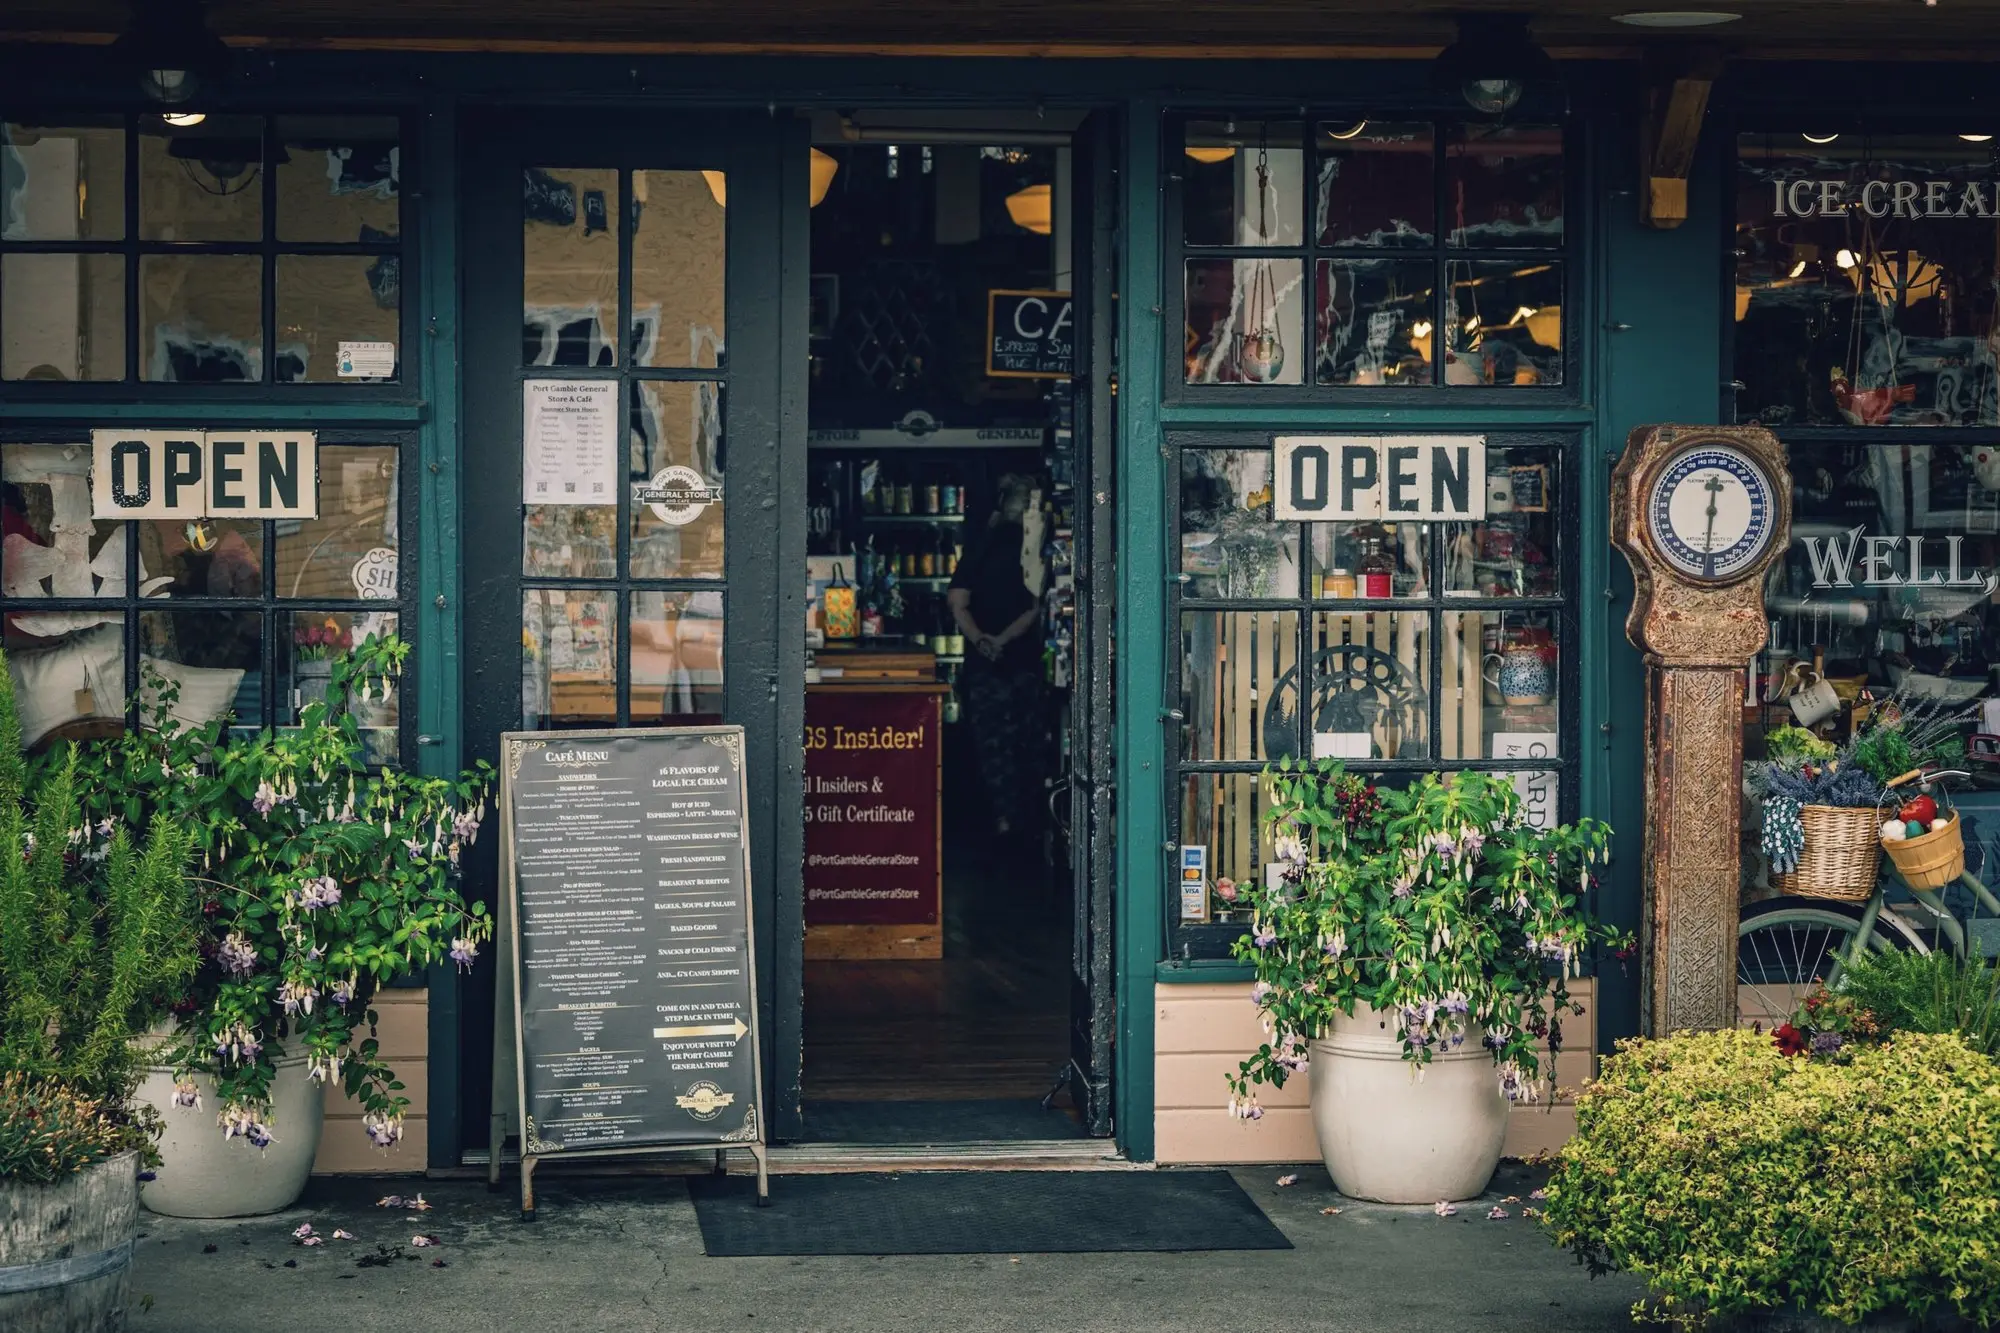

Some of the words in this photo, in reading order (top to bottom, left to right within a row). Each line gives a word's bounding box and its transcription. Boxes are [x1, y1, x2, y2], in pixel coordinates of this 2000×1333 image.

[1773, 180, 1849, 217] ICE
[1862, 180, 2000, 220] CREA
[976, 428, 1040, 440] GENERAL
[111, 441, 298, 508] OPEN
[656, 472, 670, 486] PORT
[673, 470, 699, 486] GAMBLE
[1291, 445, 1469, 512] OPEN
[1801, 523, 1999, 595] WELL,
[833, 726, 923, 749] Insider!
[546, 750, 574, 761] CAFÉ
[576, 752, 608, 760] MENU
[670, 767, 706, 775] FLAVORS
[816, 776, 868, 793] Insiders
[872, 776, 883, 792] &
[1528, 742, 1548, 839] GARD
[818, 804, 842, 822] Gift
[847, 804, 915, 822] Certificate
[809, 854, 919, 866] @PortGambleGeneralStore
[809, 888, 919, 900] @PortGambleGeneralStore
